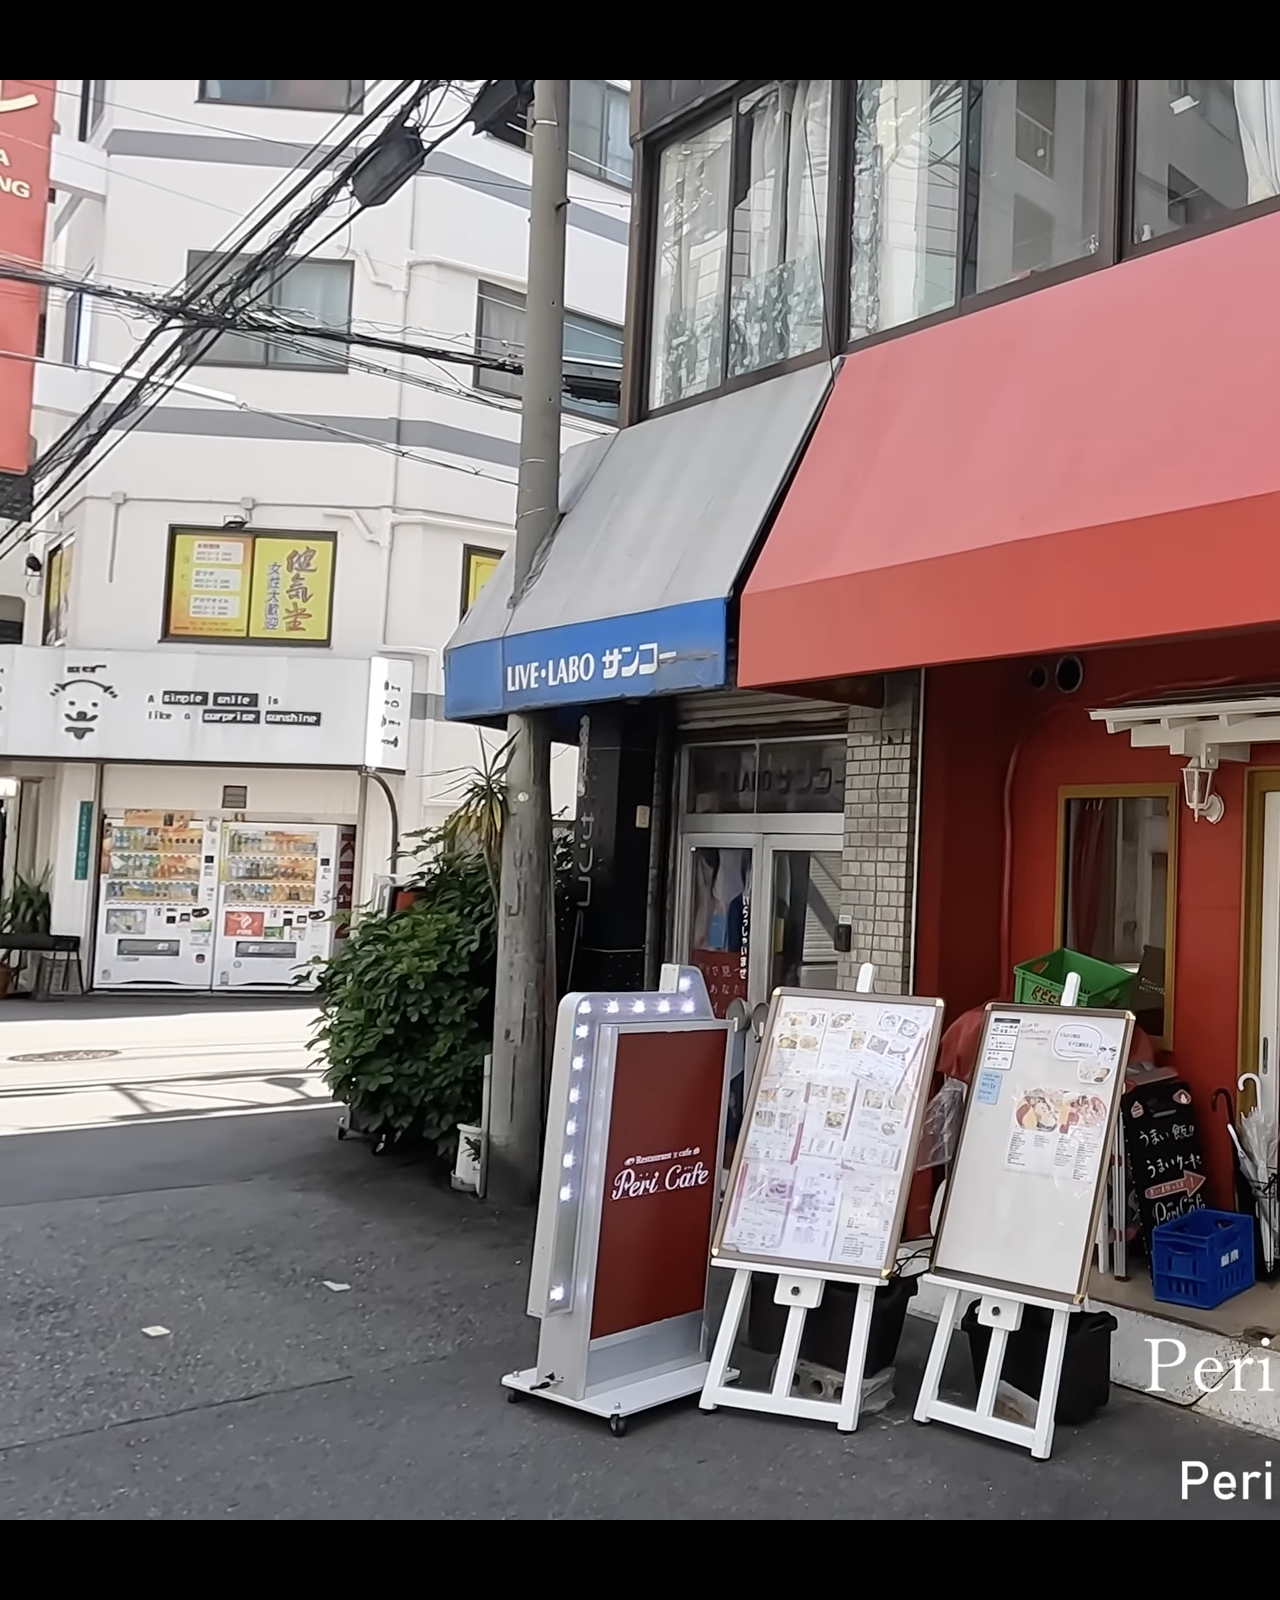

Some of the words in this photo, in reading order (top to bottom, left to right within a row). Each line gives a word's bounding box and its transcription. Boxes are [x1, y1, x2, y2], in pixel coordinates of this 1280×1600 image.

[264, 562, 282, 631] 女性大歓迎
[602, 642, 677, 679] サンコー
[148, 694, 155, 703] A
[163, 693, 203, 704] simple
[217, 695, 251, 704] smile
[268, 696, 279, 705] is
[148, 711, 172, 720] like
[203, 712, 256, 722] surprise
[266, 712, 318, 724] sunshine
[636, 1152, 672, 1164] Restaurant
[678, 1147, 692, 1157] cafe
[611, 1168, 660, 1200] Peri
[665, 1161, 709, 1190] Cafe
